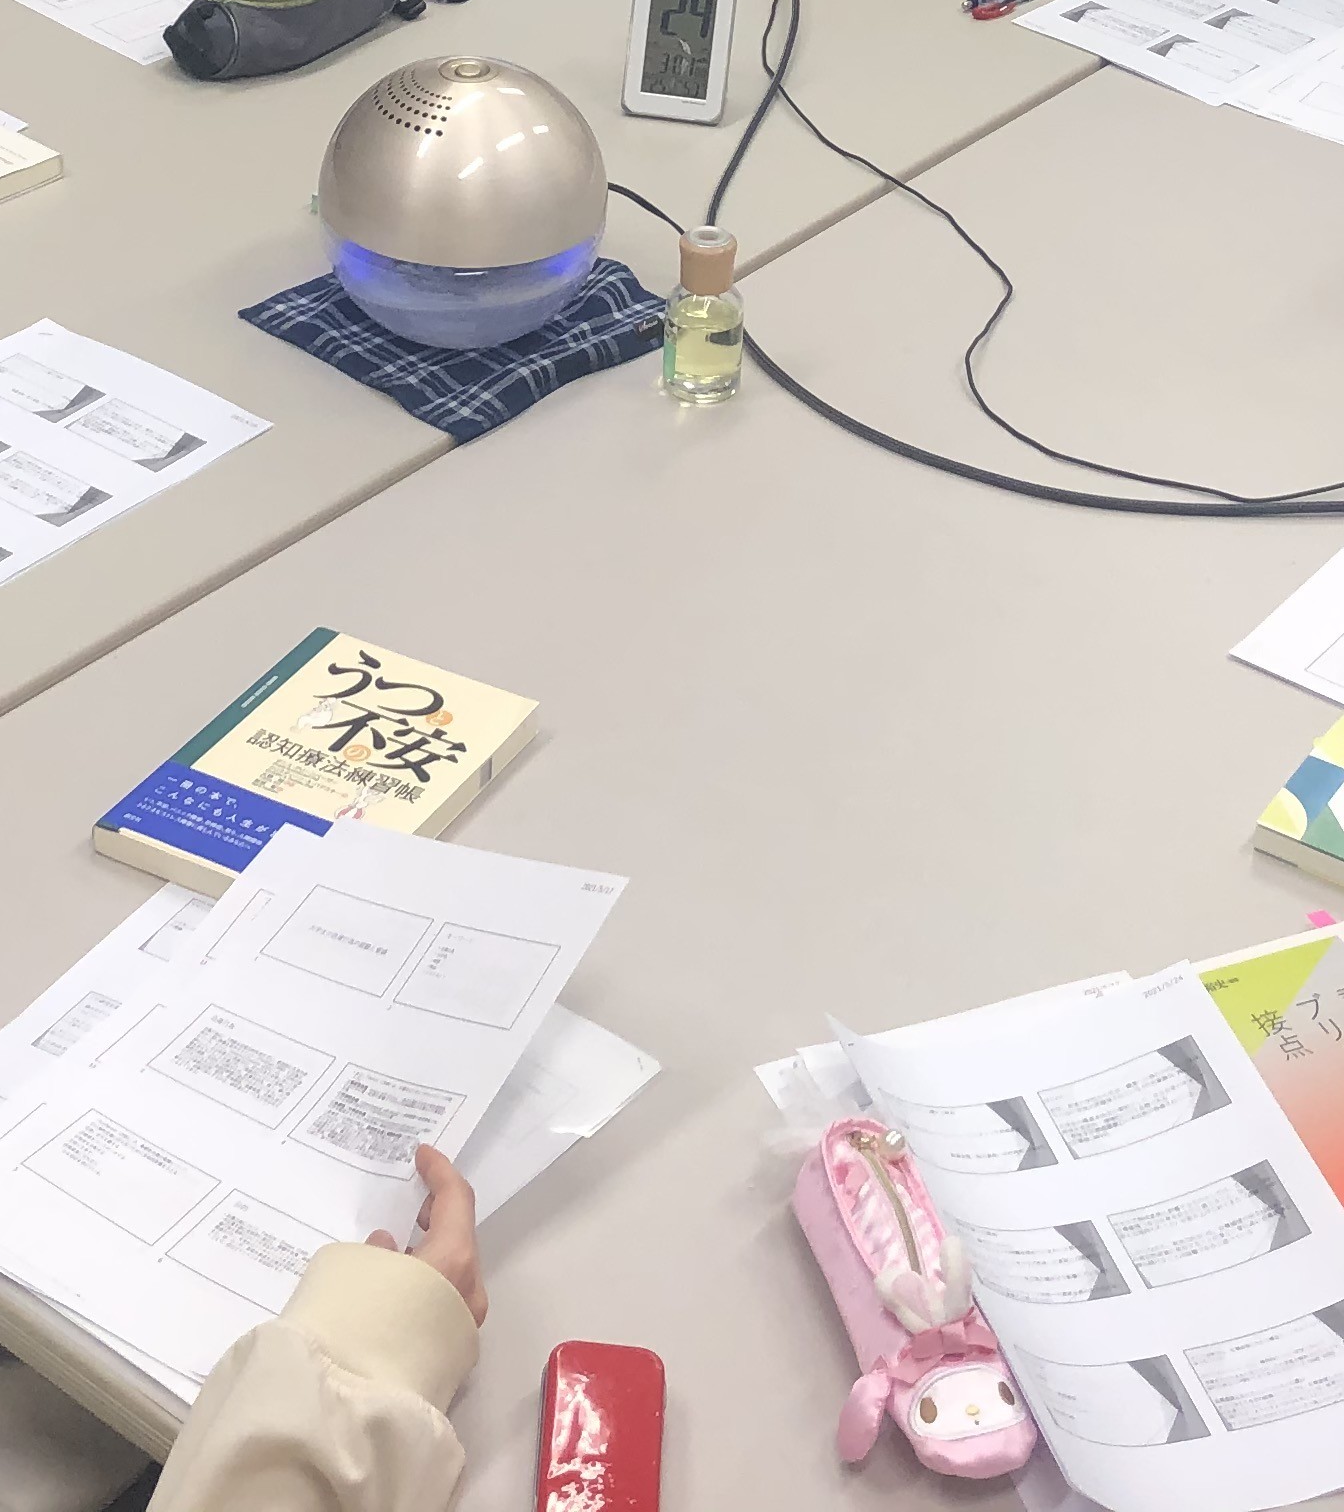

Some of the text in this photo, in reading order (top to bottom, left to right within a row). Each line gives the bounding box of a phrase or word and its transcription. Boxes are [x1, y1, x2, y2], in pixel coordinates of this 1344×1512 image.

[246, 727, 425, 806] 認知療法練習帳
[1251, 1009, 1314, 1062] 接点
